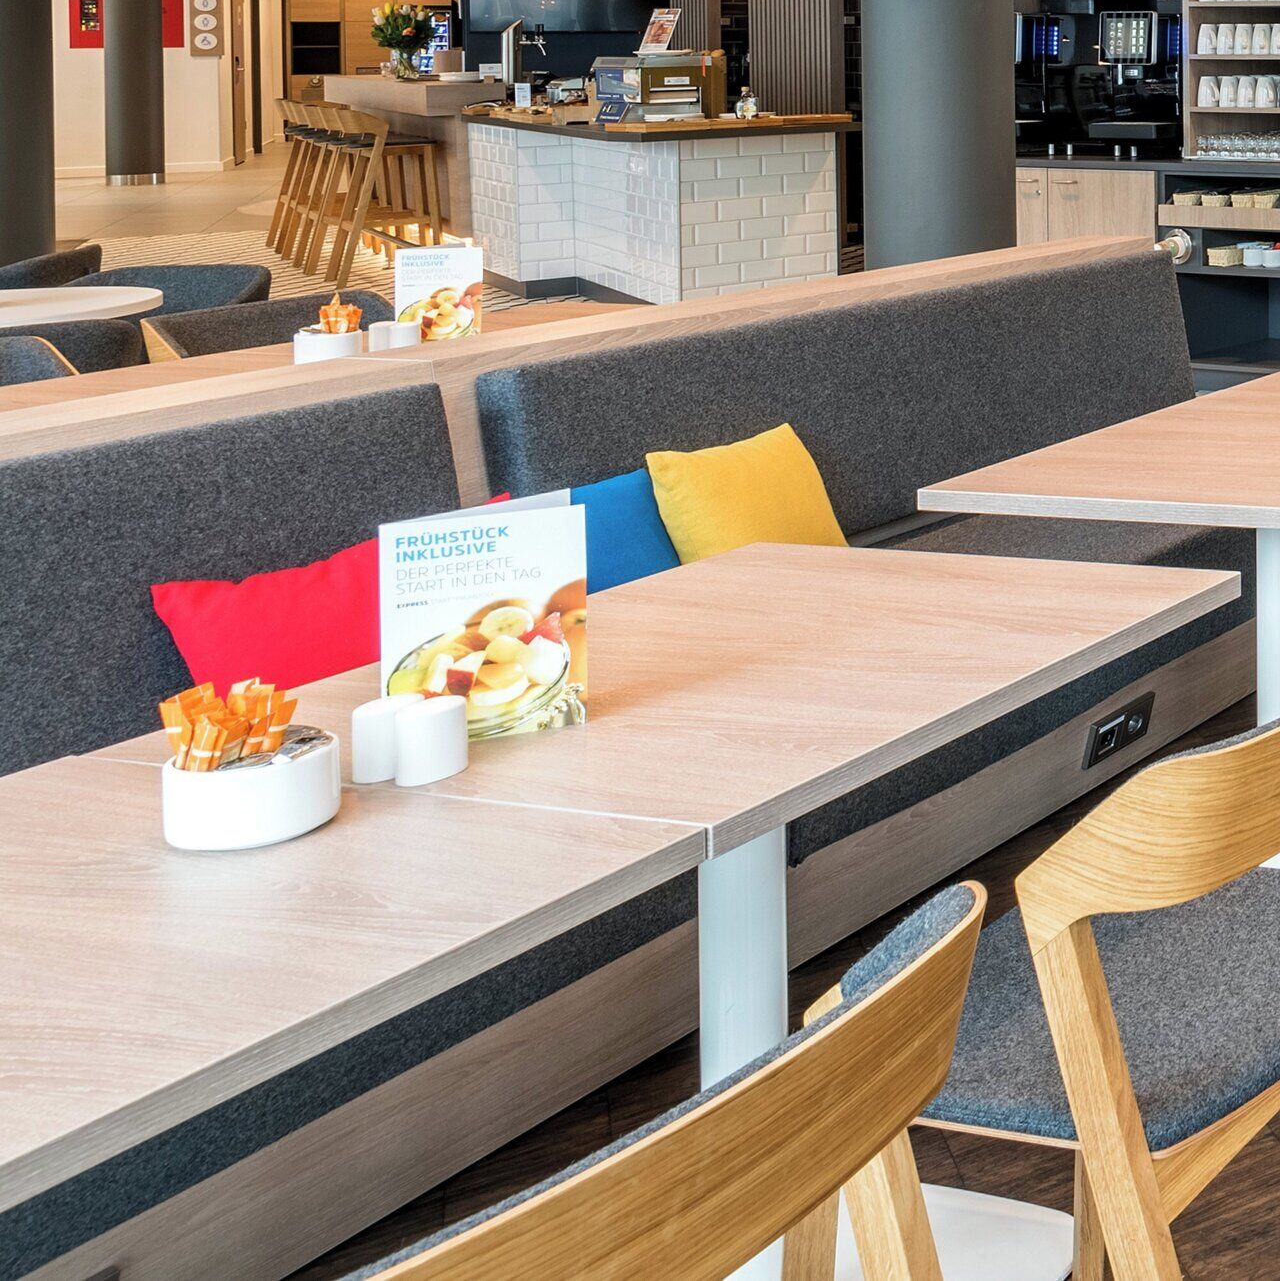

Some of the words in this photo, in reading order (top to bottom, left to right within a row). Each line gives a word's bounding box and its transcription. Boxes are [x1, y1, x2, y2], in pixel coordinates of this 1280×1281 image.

[395, 525, 510, 549] FRÜHSTÜCK
[395, 540, 497, 563] INKLUSIVE
[396, 566, 429, 581] DER
[434, 556, 514, 576] PERFEKTE
[395, 578, 446, 596] START
[451, 575, 467, 589] IN
[473, 571, 506, 586] DEN
[512, 566, 542, 581] TAG
[396, 600, 429, 609] EXPRESS
